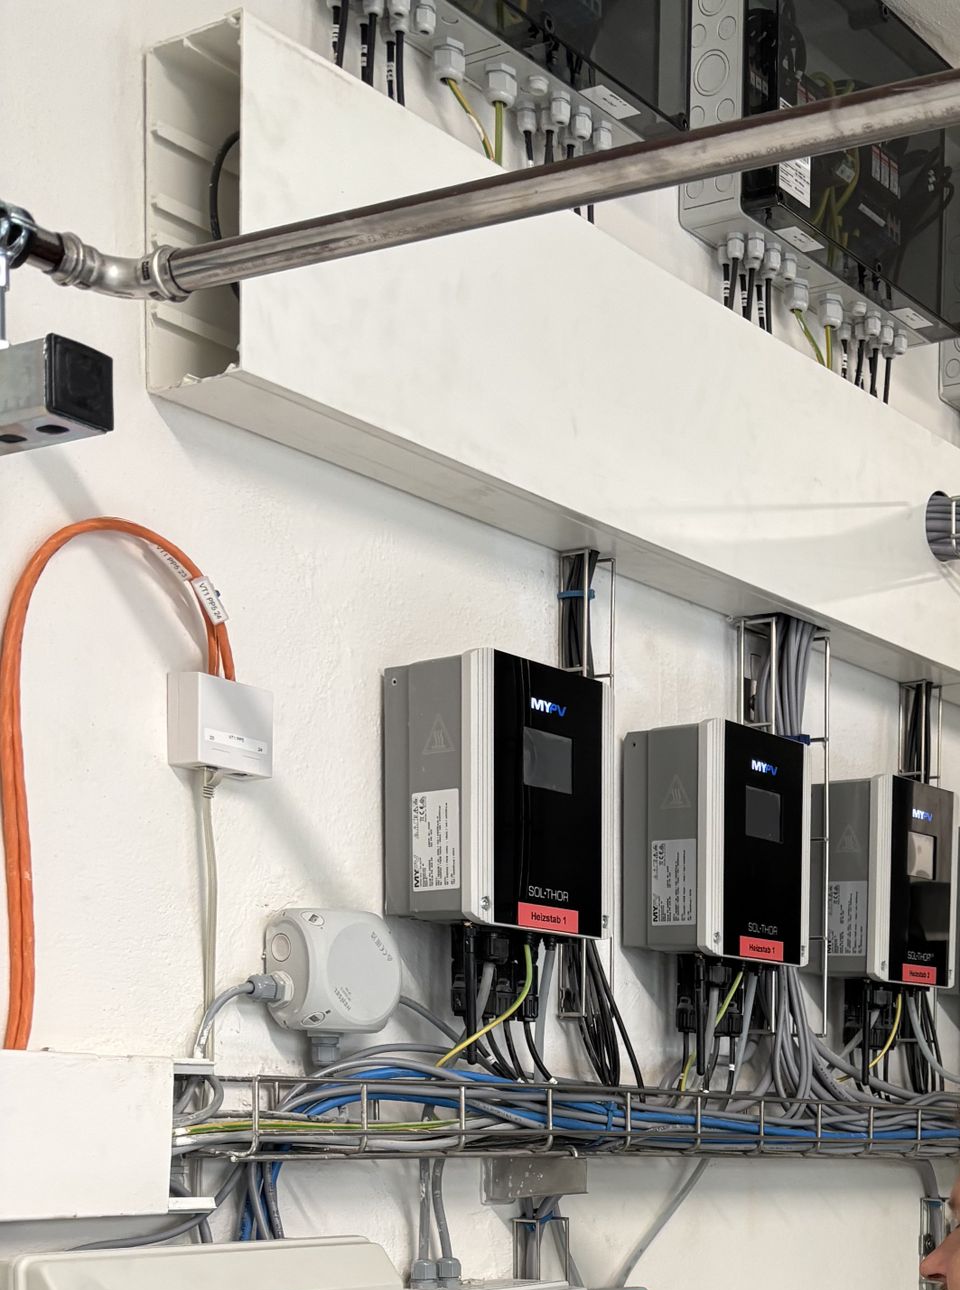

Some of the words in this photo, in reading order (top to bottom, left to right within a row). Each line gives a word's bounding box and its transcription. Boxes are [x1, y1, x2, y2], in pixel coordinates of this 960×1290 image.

[199, 582, 210, 596] VT1
[531, 911, 562, 924] Heizstab
[563, 916, 567, 925] 1
